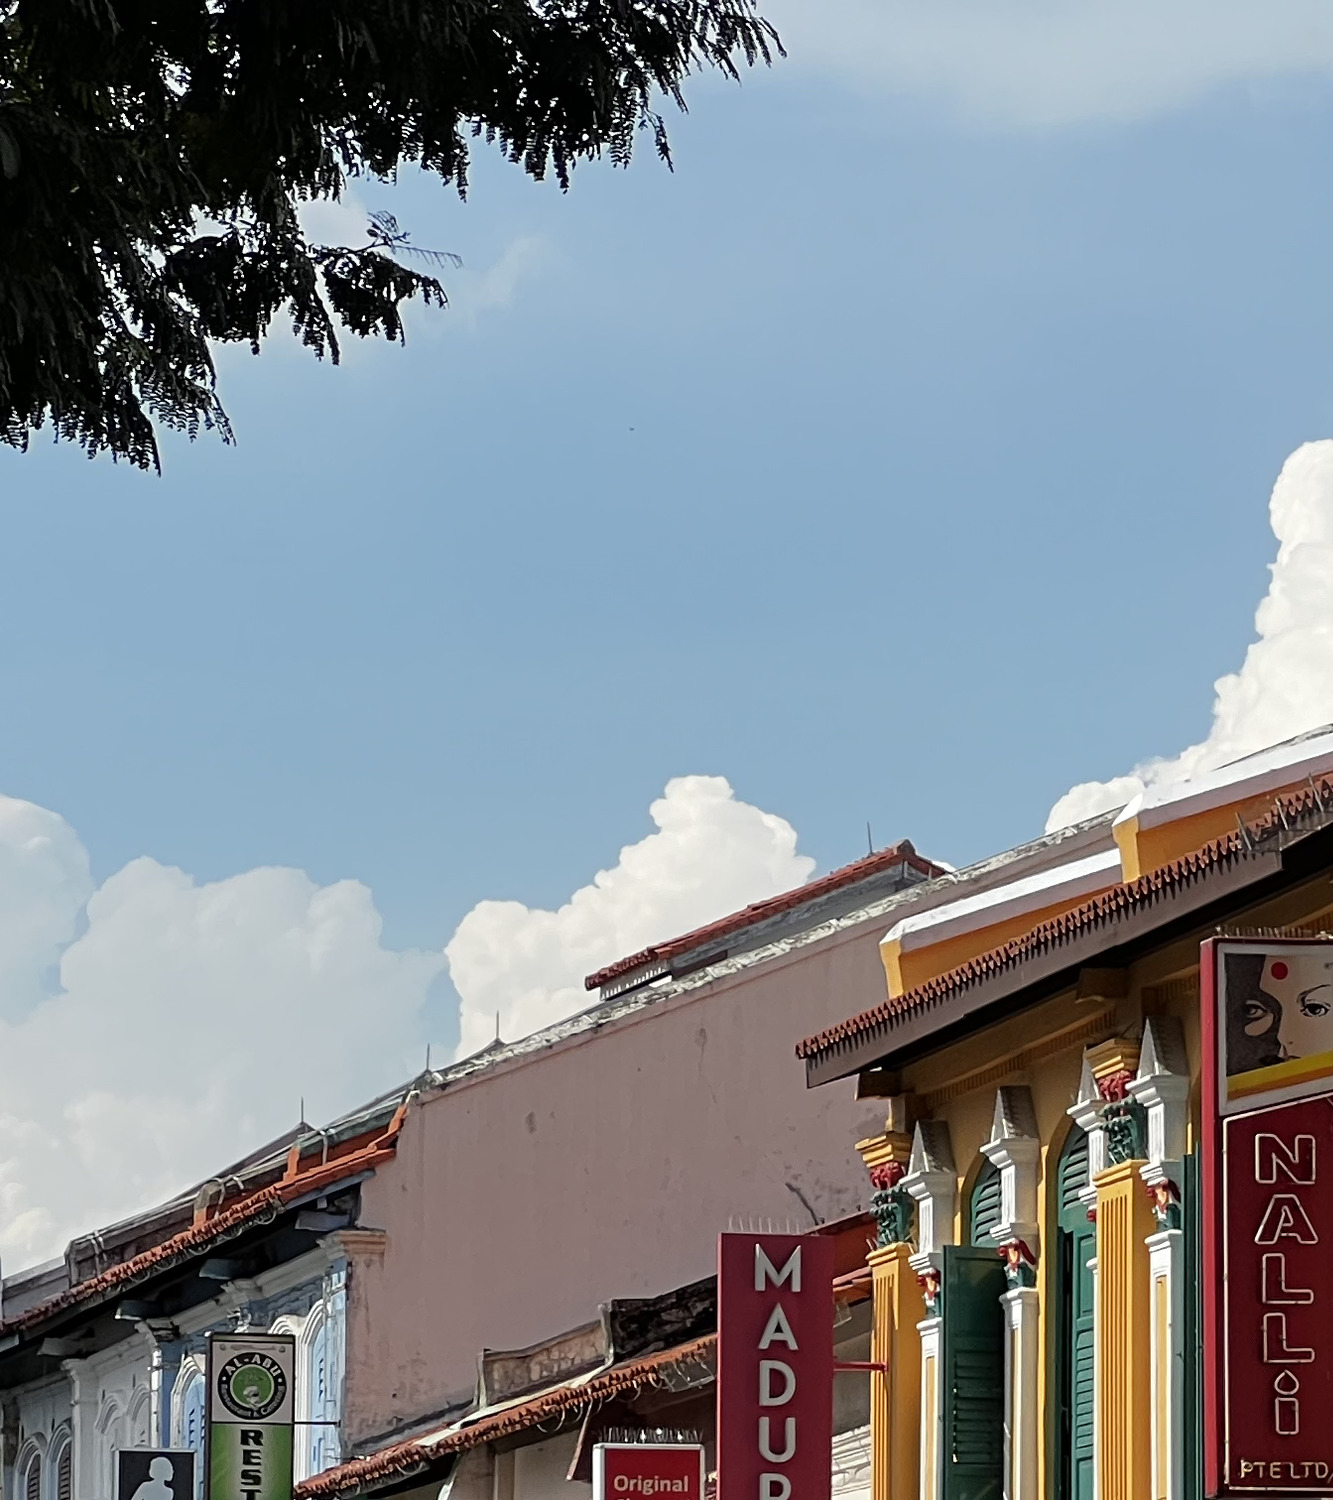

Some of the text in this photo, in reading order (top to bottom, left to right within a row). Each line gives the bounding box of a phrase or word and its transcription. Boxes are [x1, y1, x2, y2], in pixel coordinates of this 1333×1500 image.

[1239, 1459, 1328, 1479] PTE LTD
[613, 1475, 689, 1495] Original
